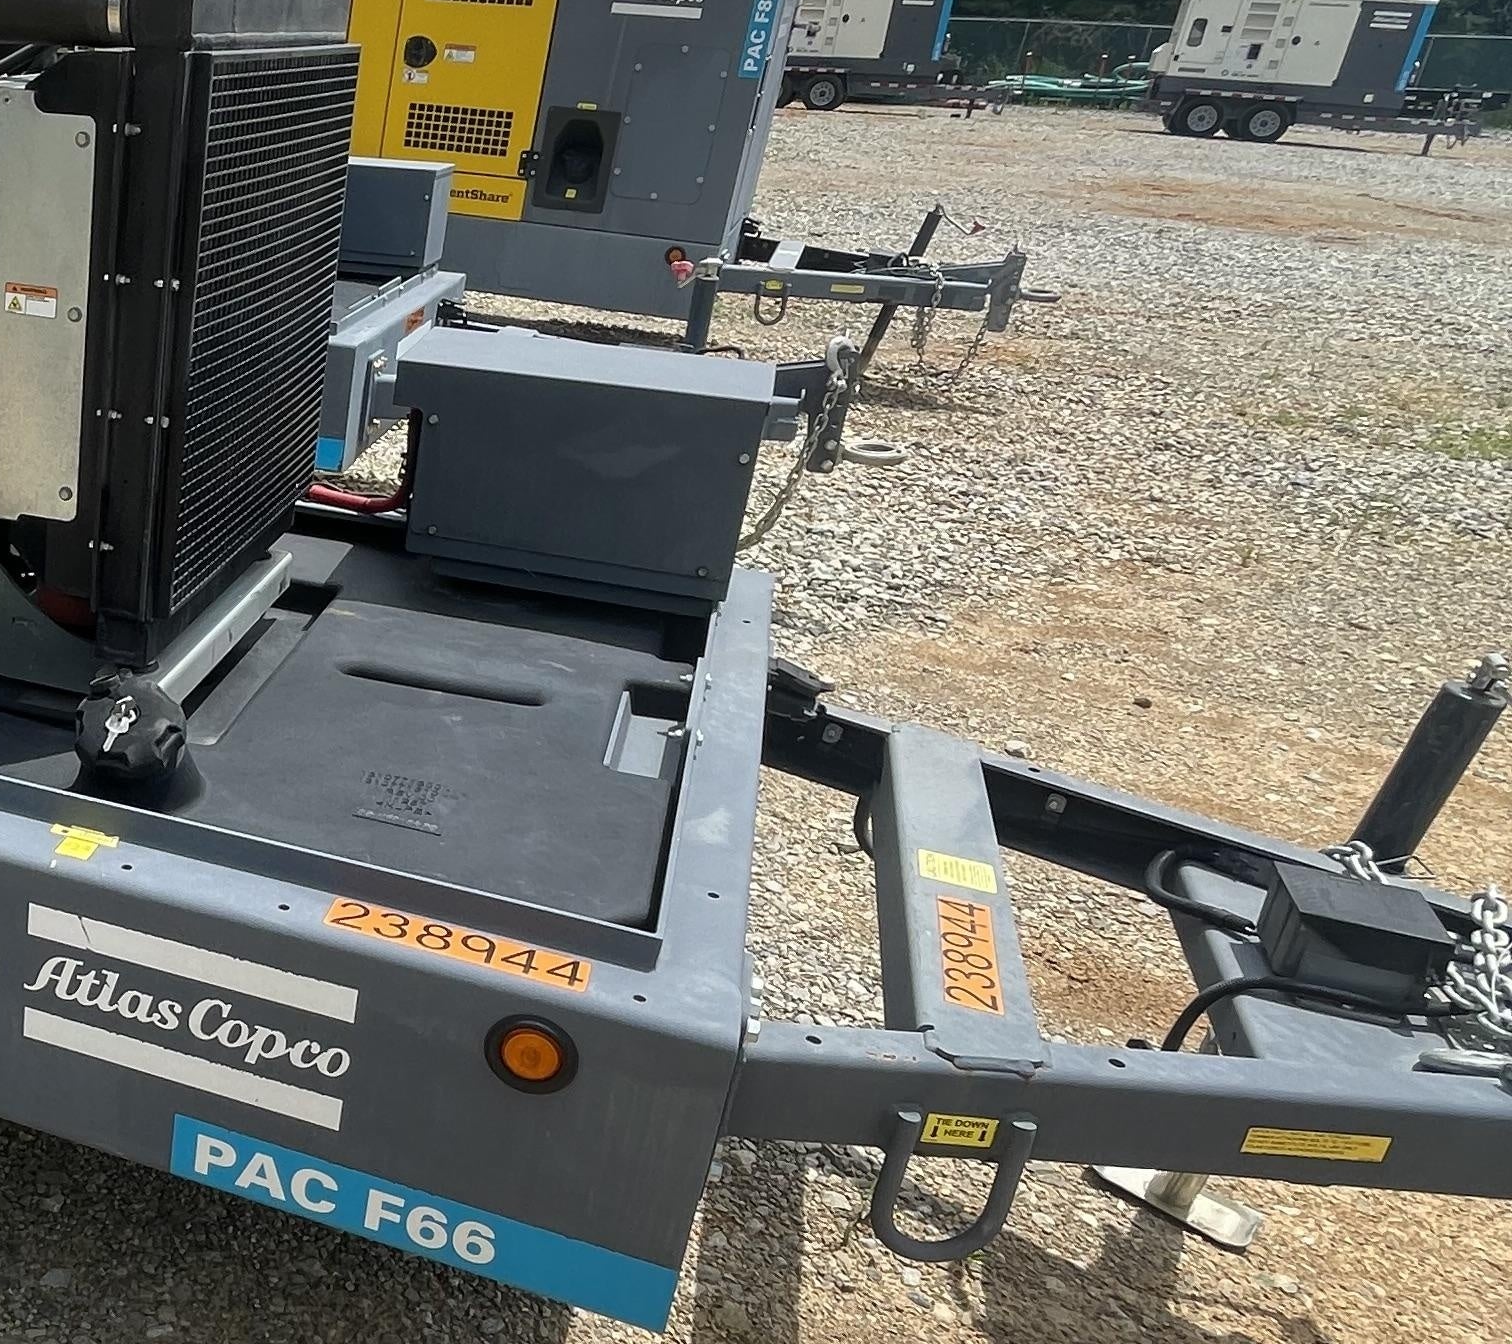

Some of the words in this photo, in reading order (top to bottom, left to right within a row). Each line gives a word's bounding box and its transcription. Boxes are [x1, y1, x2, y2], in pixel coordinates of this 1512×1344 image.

[743, 29, 766, 72] PAC
[449, 188, 509, 204] entShare
[330, 902, 584, 987] 238944
[937, 897, 999, 1012] 238944
[23, 955, 183, 1030] Atlas
[188, 998, 351, 1078] Copco
[936, 1117, 953, 1127] TIE
[954, 1119, 990, 1130] DOWN
[943, 1129, 975, 1139] HERE
[194, 1134, 339, 1214] PAC
[363, 1188, 496, 1265] F66
